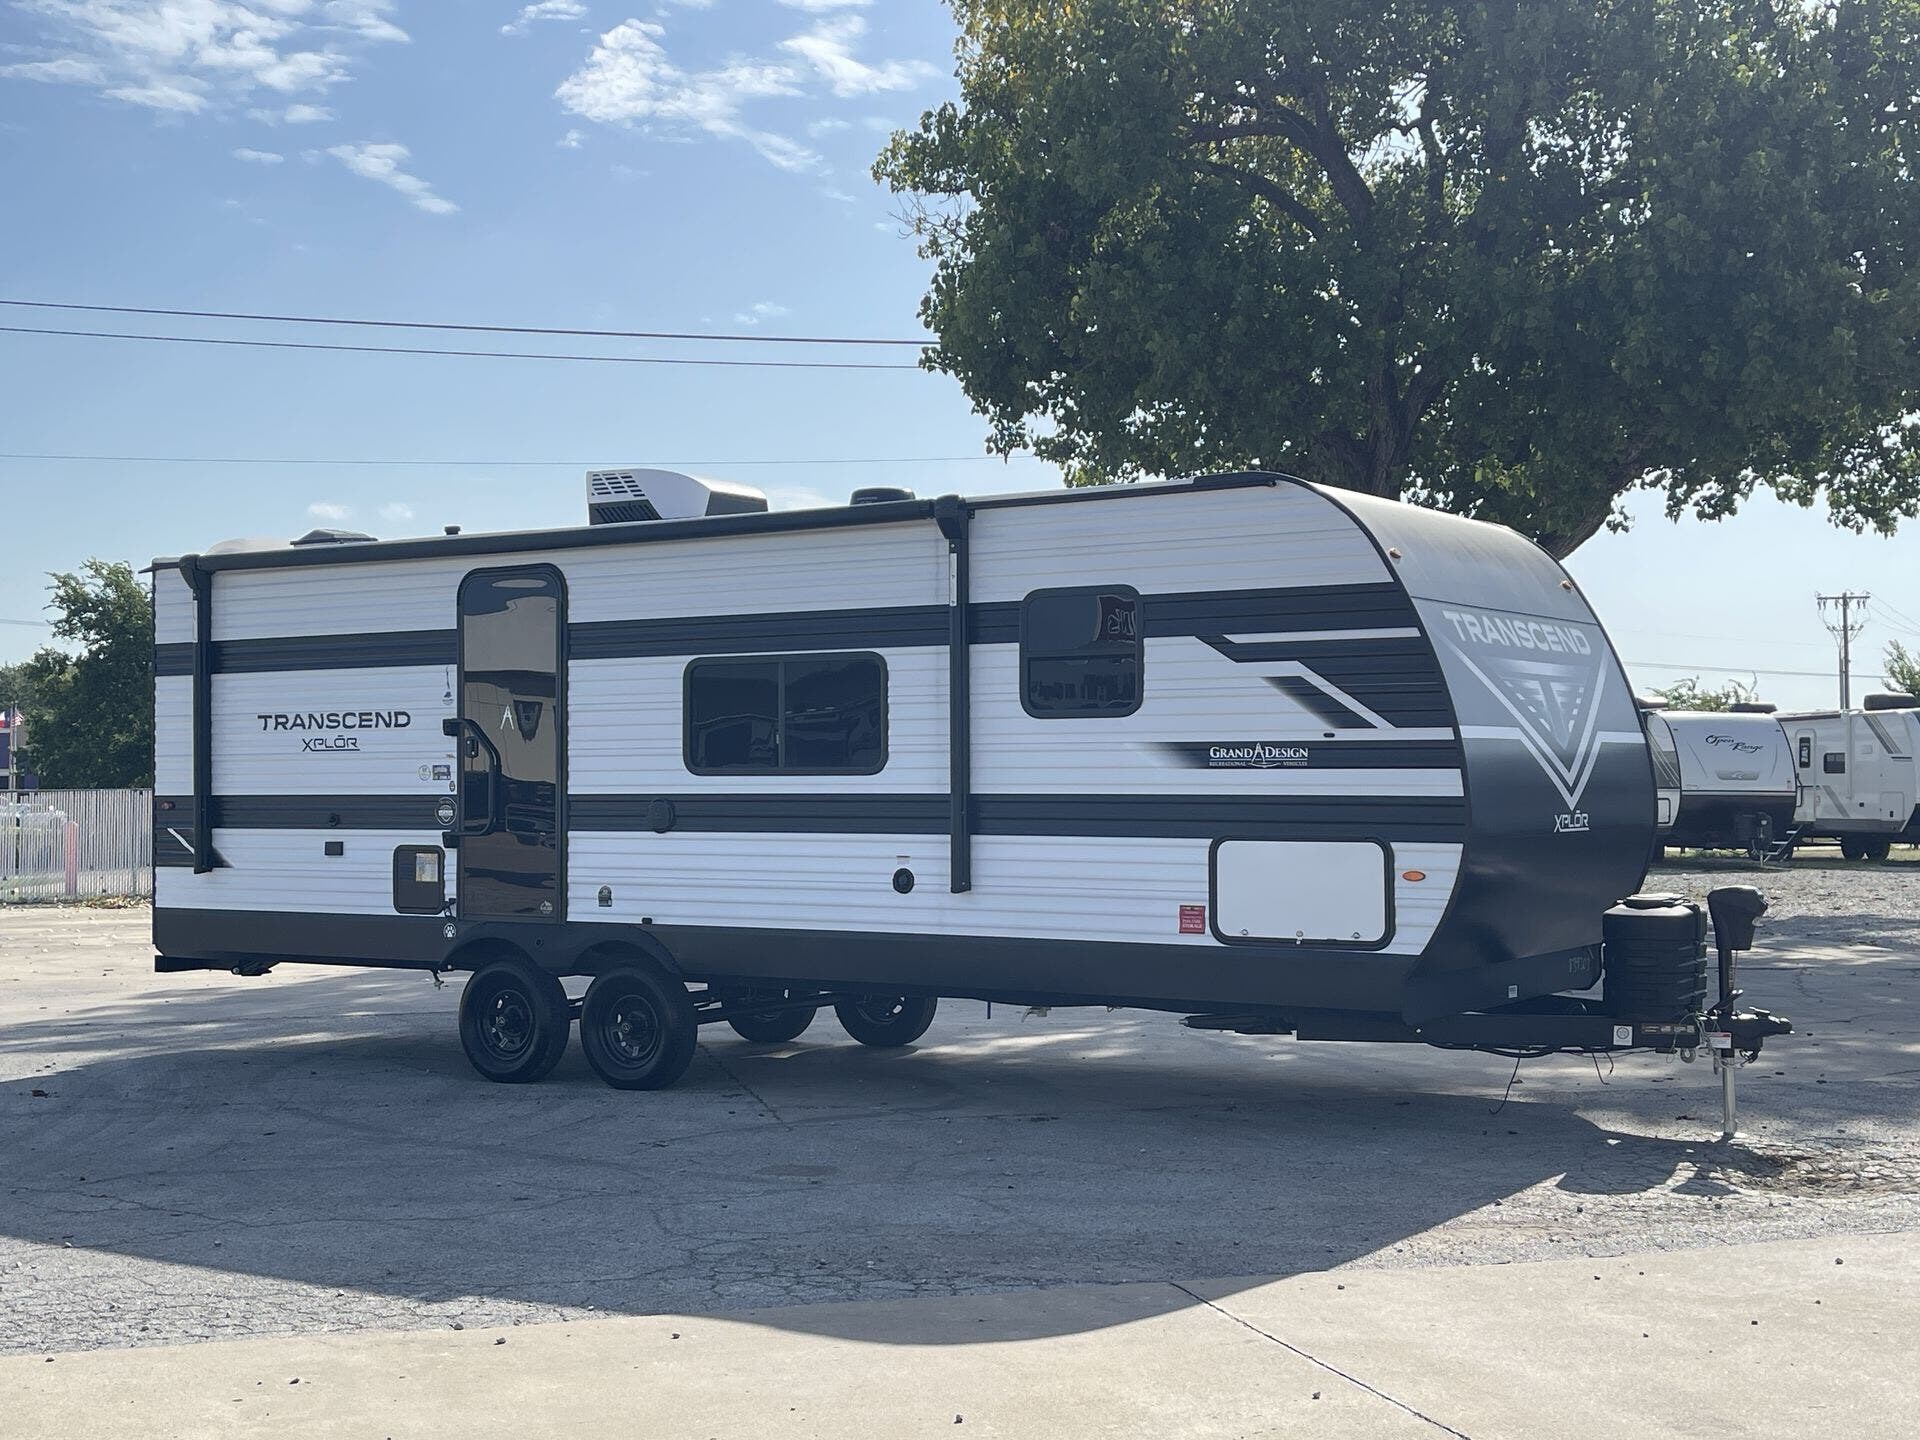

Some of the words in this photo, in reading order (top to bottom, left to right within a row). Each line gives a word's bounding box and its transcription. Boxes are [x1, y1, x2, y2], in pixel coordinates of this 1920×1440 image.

[1442, 609, 1591, 655] TRANSCEND
[257, 711, 411, 731] TRANSCEND
[1705, 734, 1735, 747] Open
[1209, 746, 1253, 758] GRAND
[1265, 746, 1308, 758] DESIGN
[1729, 742, 1764, 754] Range
